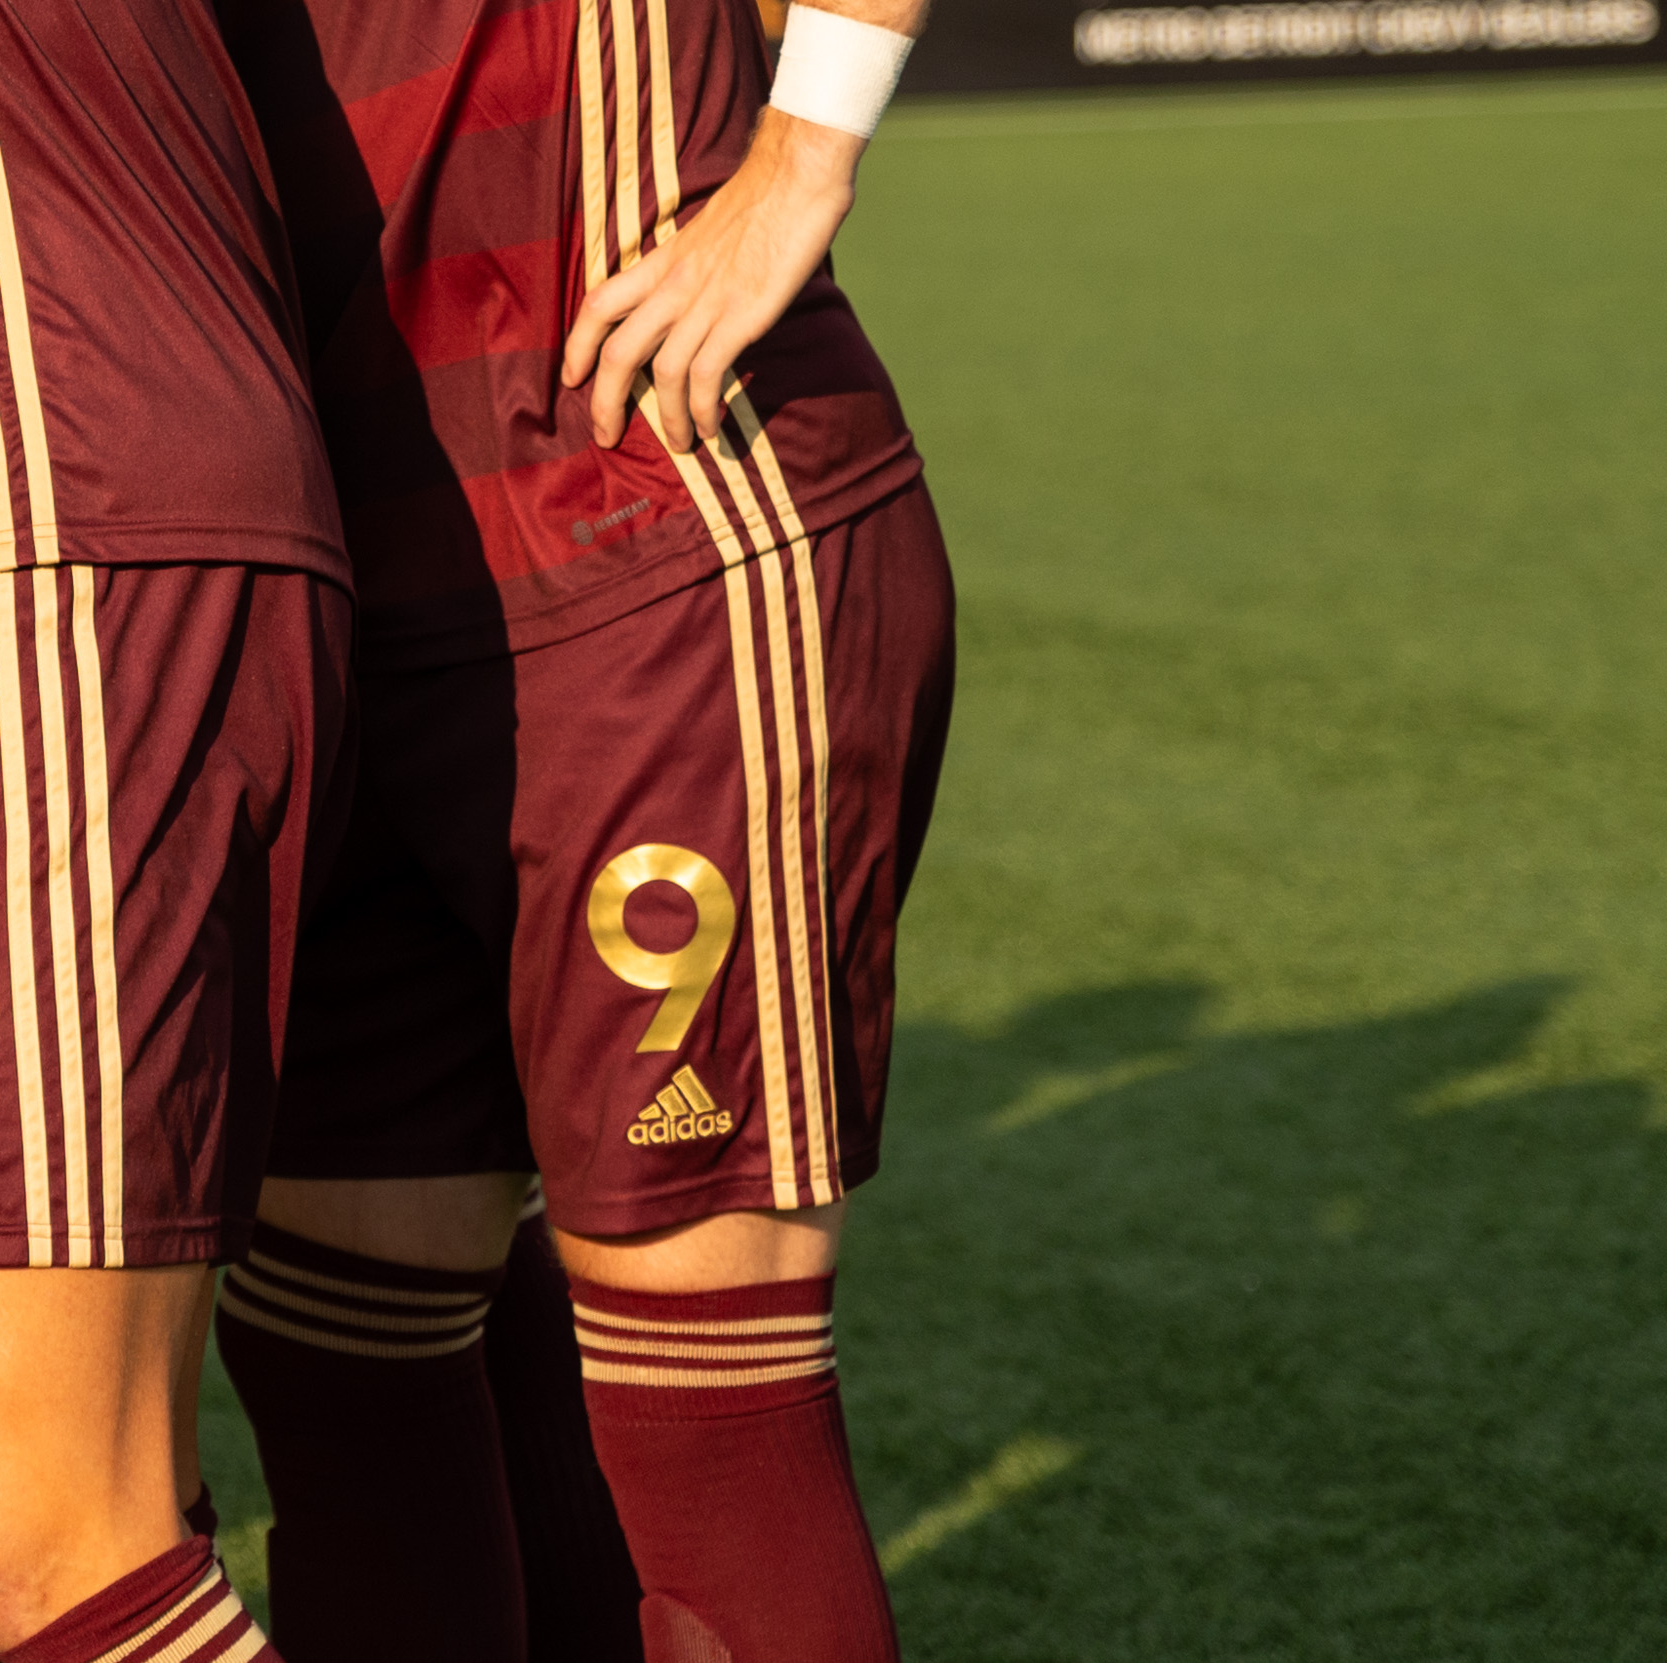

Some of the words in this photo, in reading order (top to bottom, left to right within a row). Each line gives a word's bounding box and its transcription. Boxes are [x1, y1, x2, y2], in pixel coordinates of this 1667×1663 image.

[594, 498, 650, 531] AEROREADY
[586, 843, 736, 1054] 9
[627, 1108, 733, 1146] adidas
